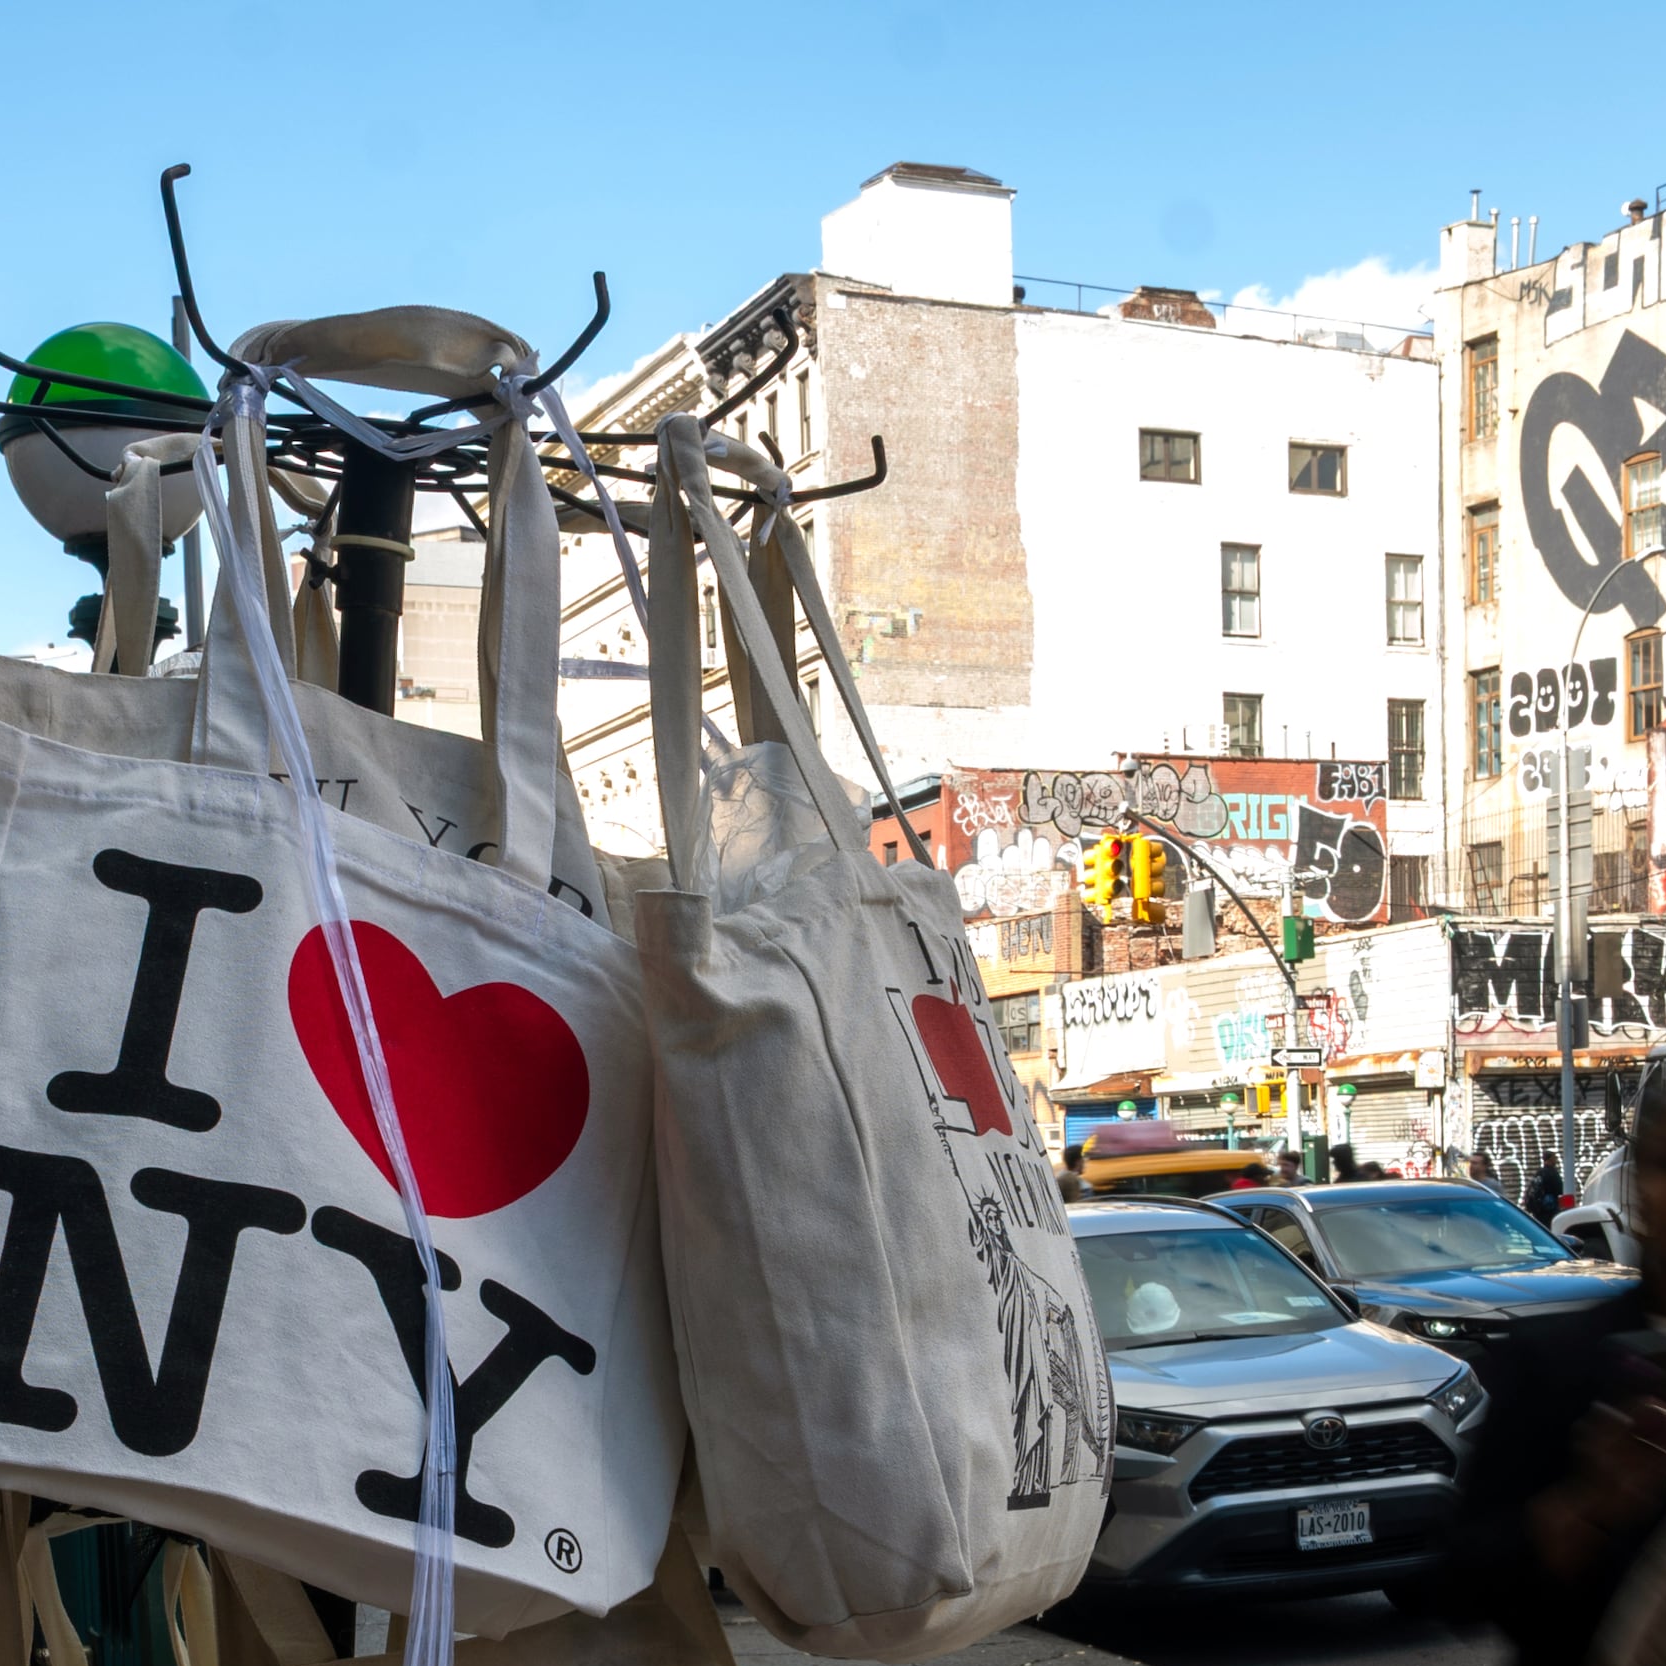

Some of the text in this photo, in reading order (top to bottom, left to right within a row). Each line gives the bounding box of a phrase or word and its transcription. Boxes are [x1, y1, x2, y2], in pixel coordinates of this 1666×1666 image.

[45, 847, 263, 1133] I
[1299, 1510, 1366, 1538] LAS 2010
